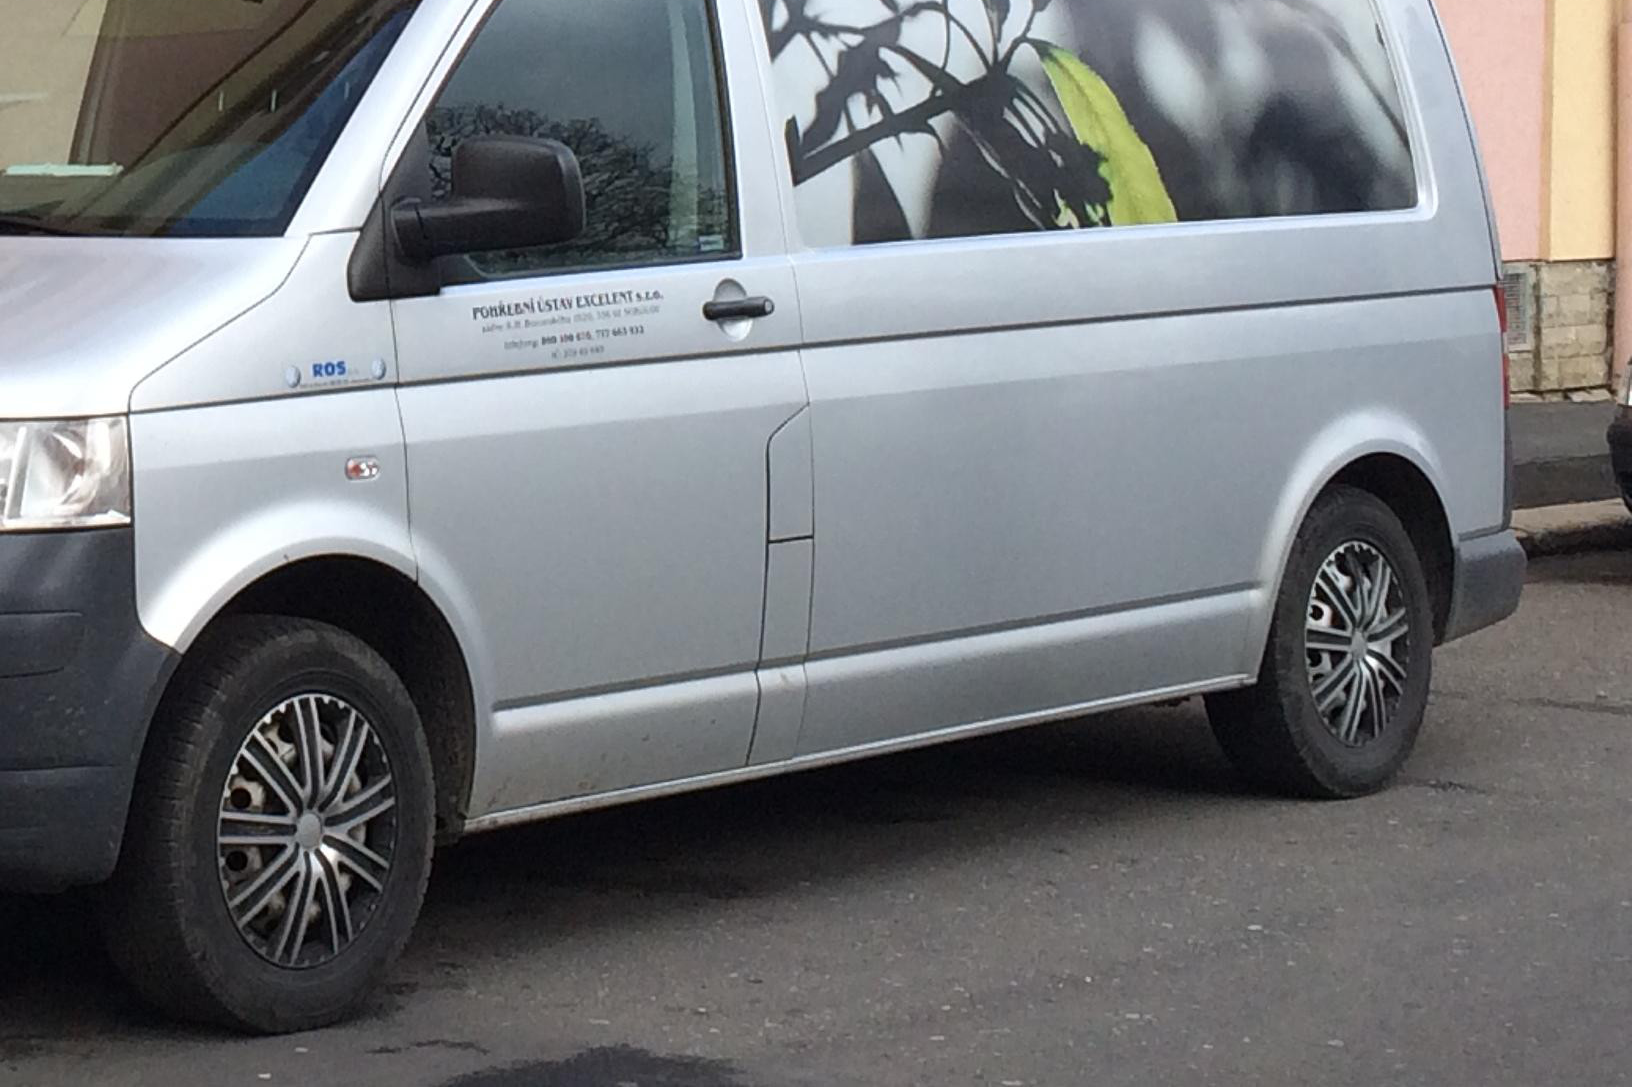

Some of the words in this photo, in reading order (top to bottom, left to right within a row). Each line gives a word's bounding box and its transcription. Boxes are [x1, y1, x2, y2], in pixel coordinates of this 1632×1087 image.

[473, 297, 534, 320] POHŘEBNÍ
[537, 296, 573, 313] ÚSTAV
[576, 290, 633, 309] EXCELENT
[312, 360, 346, 377] ROS
